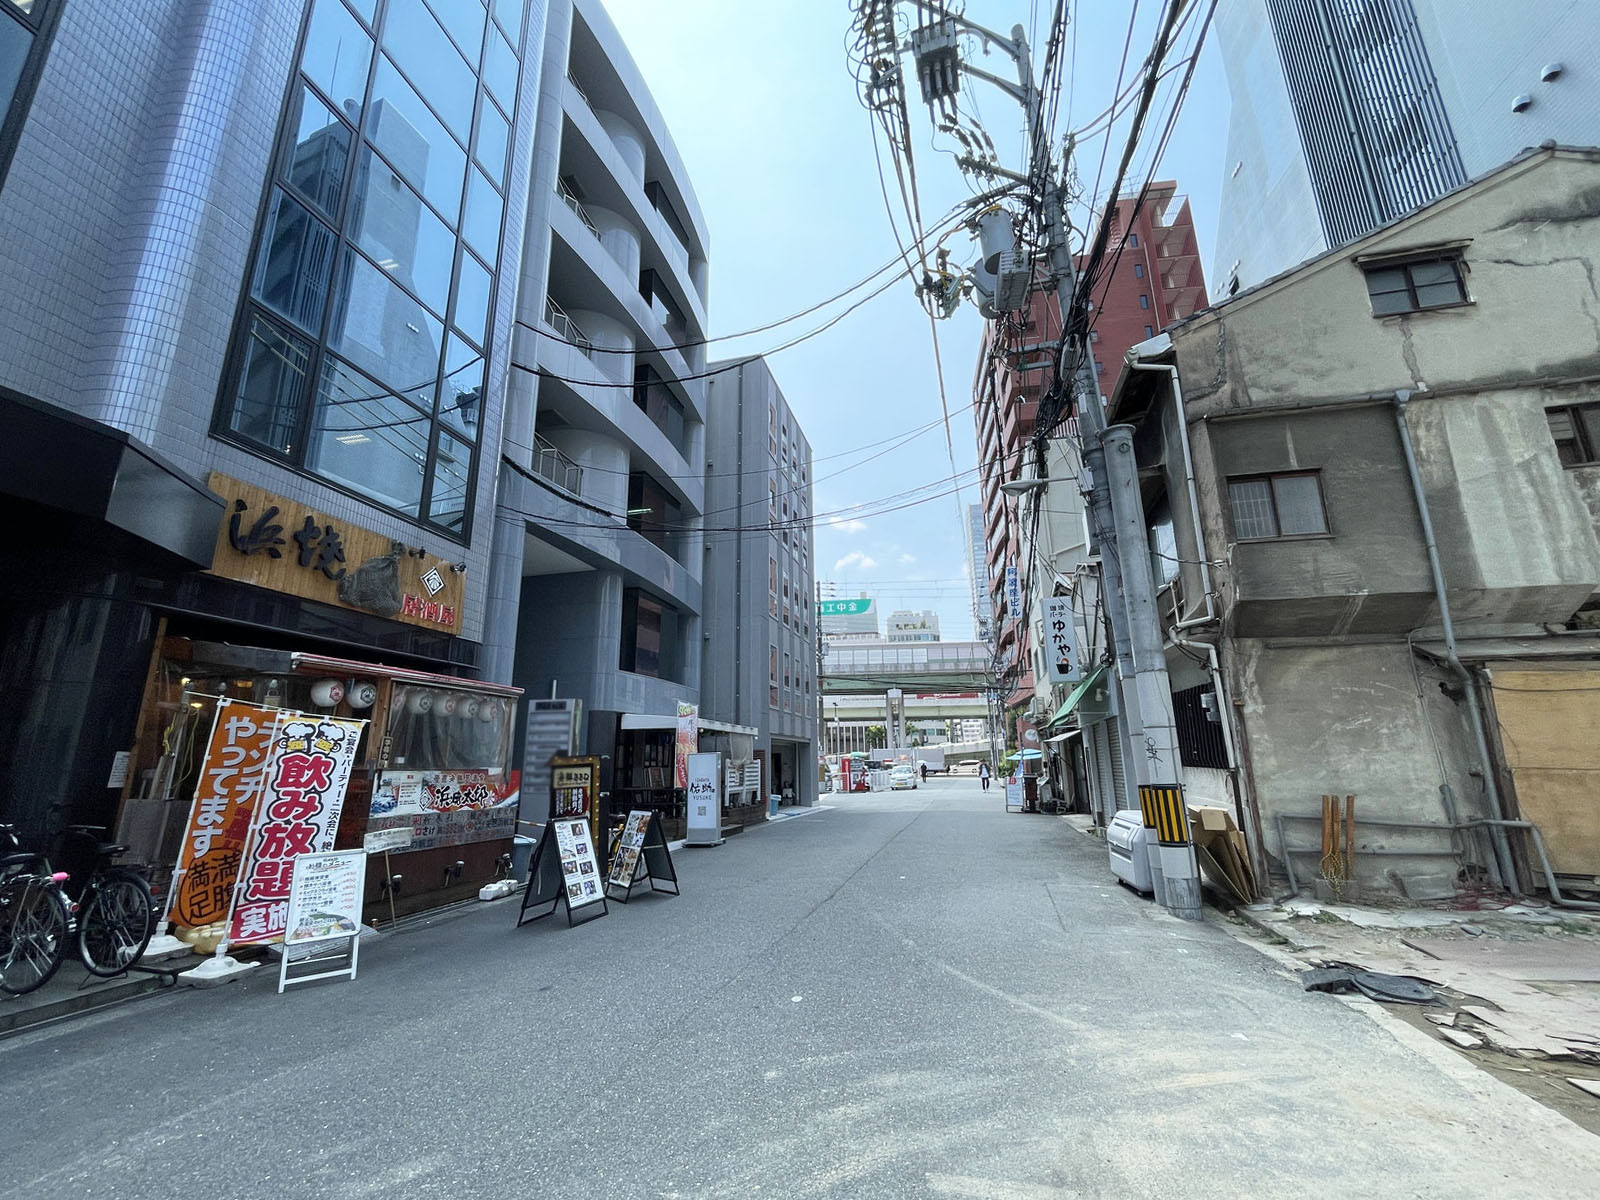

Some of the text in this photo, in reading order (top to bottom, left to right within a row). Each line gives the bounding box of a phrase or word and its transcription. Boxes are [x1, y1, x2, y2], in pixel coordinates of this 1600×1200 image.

[229, 498, 347, 581] 浜焼
[400, 593, 456, 628] 居酒屋
[1052, 619, 1071, 656] ゆかや
[191, 716, 257, 859] やってます
[235, 721, 283, 804] ランチ
[245, 754, 332, 900] 飲み放題
[188, 861, 215, 921] 満足
